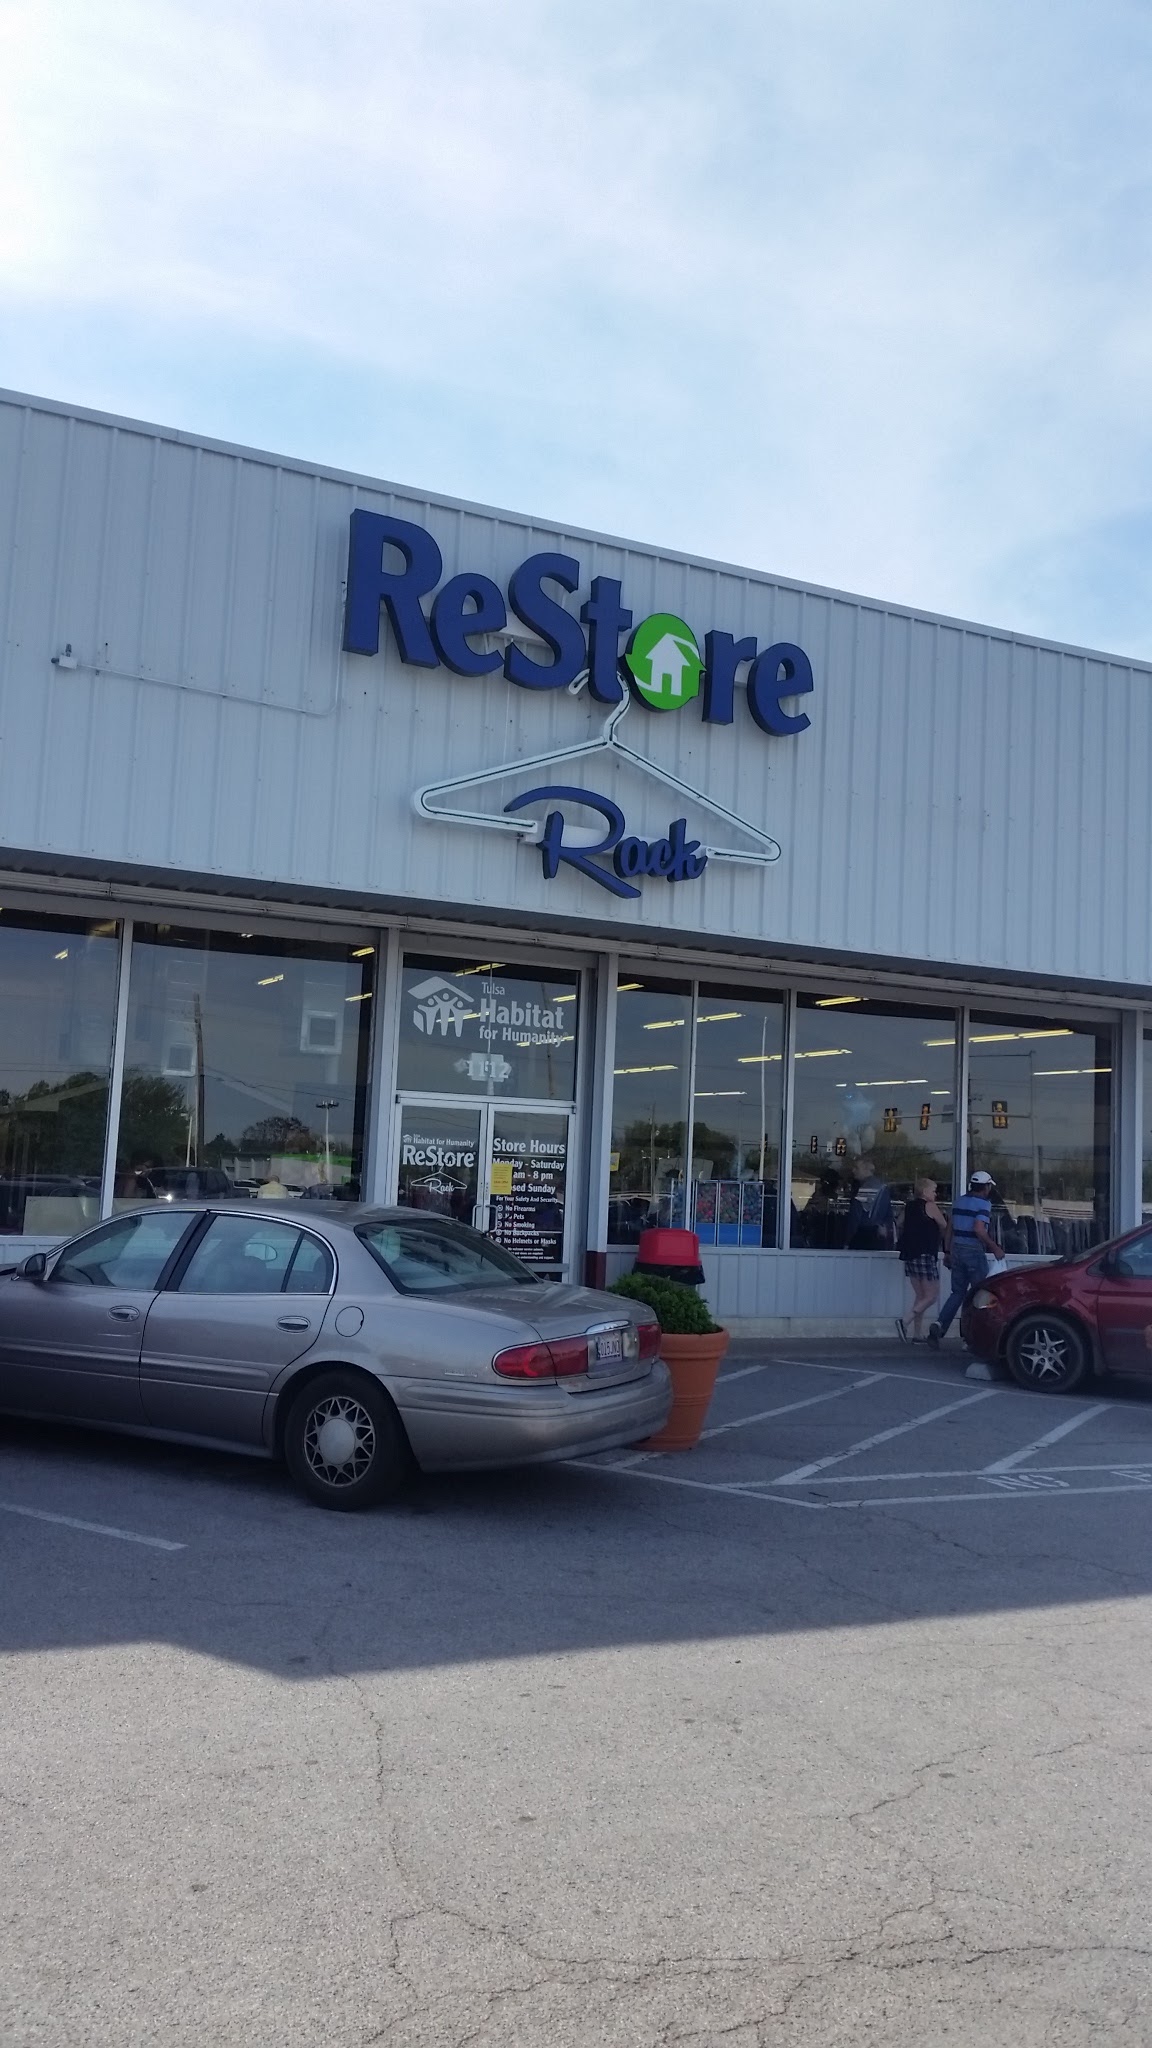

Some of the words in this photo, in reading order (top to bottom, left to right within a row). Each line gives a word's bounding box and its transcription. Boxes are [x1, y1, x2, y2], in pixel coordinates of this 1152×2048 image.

[342, 508, 814, 737] ReStore
[504, 786, 708, 899] Rack
[481, 982, 506, 996] Tulsa
[479, 998, 564, 1030] Habitat
[479, 1025, 498, 1040] for
[502, 1027, 564, 1048] Humanity
[413, 1136, 435, 1145] Habitat
[446, 1139, 475, 1148] Humanity
[493, 1137, 526, 1153] Store
[530, 1139, 566, 1154] Hours
[402, 1144, 475, 1168] ReStore
[530, 1159, 565, 1172] Saturday
[513, 1171, 526, 1179] am
[533, 1170, 539, 1180] 8
[541, 1172, 554, 1182] pm
[423, 1178, 456, 1195] Rack
[511, 1183, 526, 1192] sed
[527, 1183, 556, 1195] Sunday
[513, 1221, 536, 1229] Smoking
